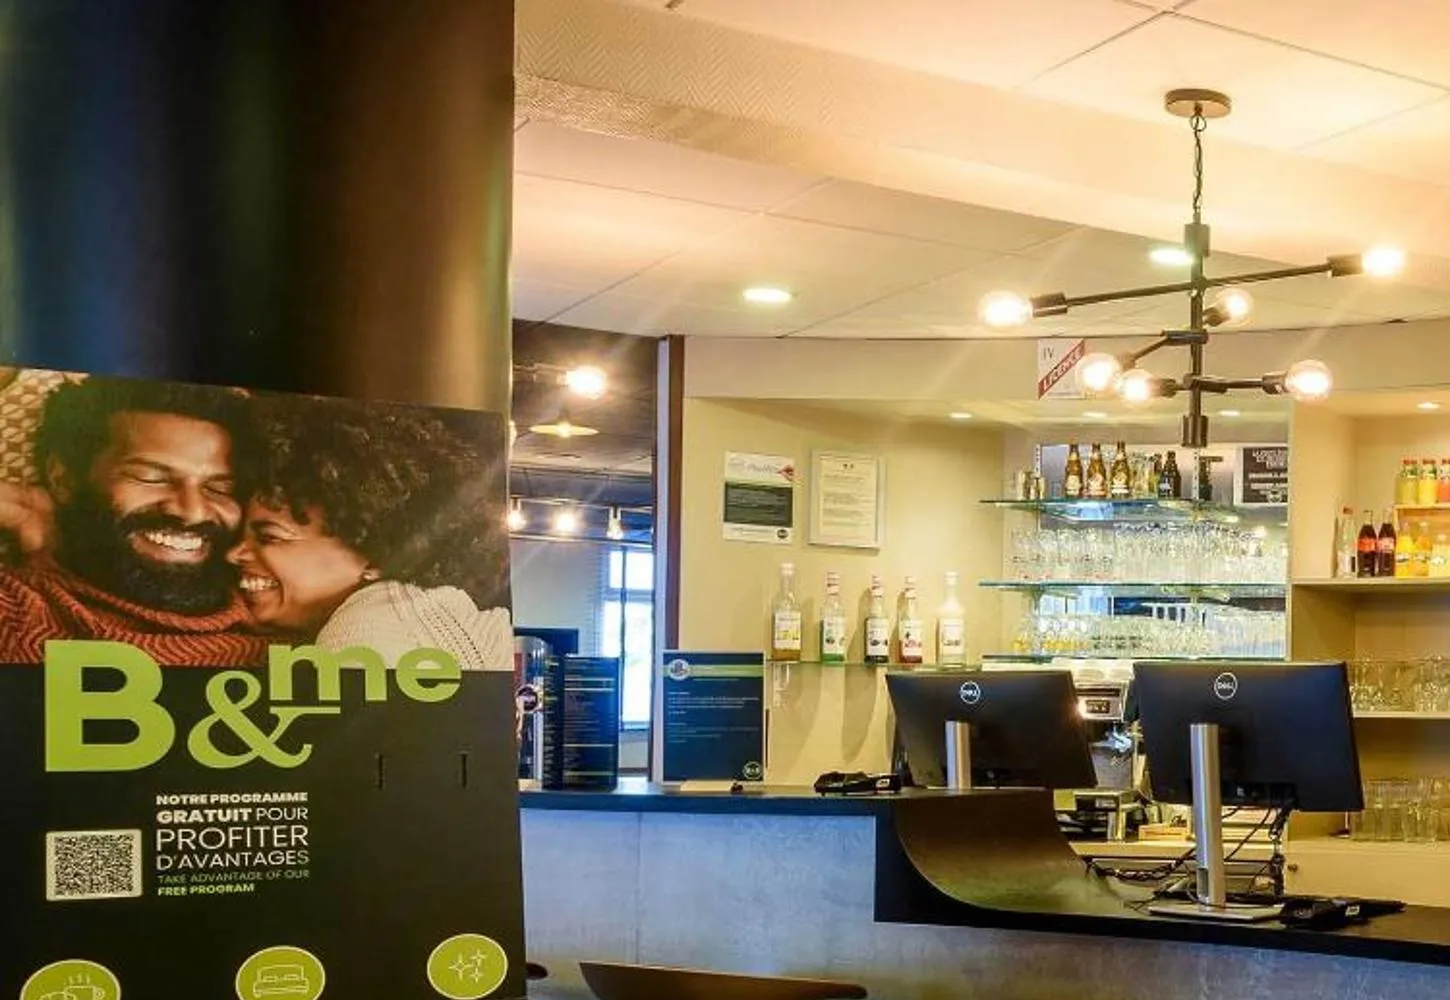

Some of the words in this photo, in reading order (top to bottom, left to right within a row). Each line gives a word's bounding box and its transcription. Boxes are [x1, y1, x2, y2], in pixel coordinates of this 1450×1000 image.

[45, 639, 461, 772] B&me
[156, 793, 208, 805] NOTRE
[210, 791, 308, 804] PROGRAMME
[156, 808, 252, 824] GRATUIT
[255, 807, 309, 821] POUR
[156, 825, 309, 851] PROFITER
[156, 850, 310, 870] D'AVANTAGES
[157, 874, 187, 884] TAKE
[190, 871, 263, 883] ADVANTAGE
[266, 870, 282, 880] OF
[284, 869, 310, 879] OUR
[157, 886, 188, 896] FREE
[190, 883, 255, 895] PROGRAM
